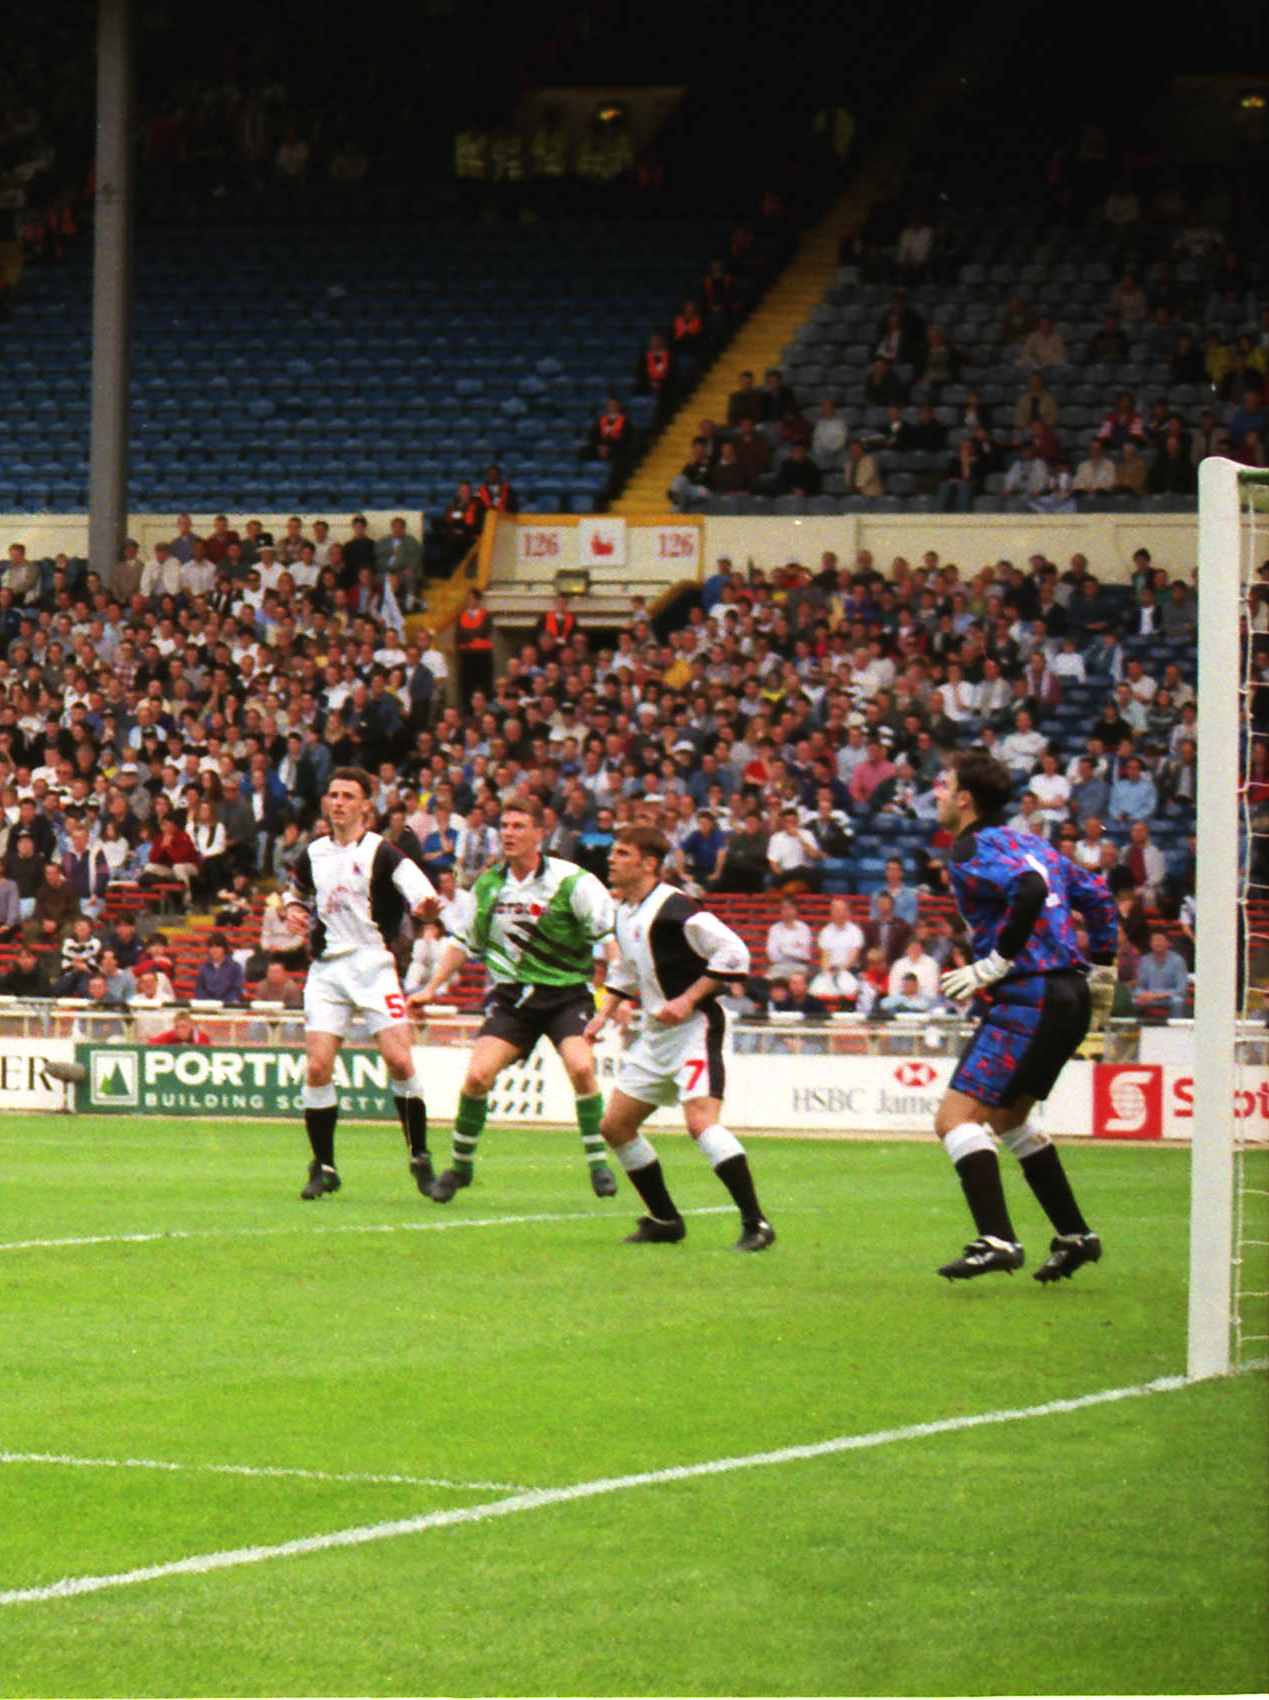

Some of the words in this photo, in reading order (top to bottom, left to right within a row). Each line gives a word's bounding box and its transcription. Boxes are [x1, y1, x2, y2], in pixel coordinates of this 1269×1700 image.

[523, 532, 559, 557] 126
[657, 532, 694, 558] 126
[384, 993, 405, 1019] 5
[685, 1059, 708, 1091] 7
[144, 1092, 264, 1110] BUILDING
[275, 1094, 387, 1112] SOETY
[792, 1085, 866, 1114] HSBC
